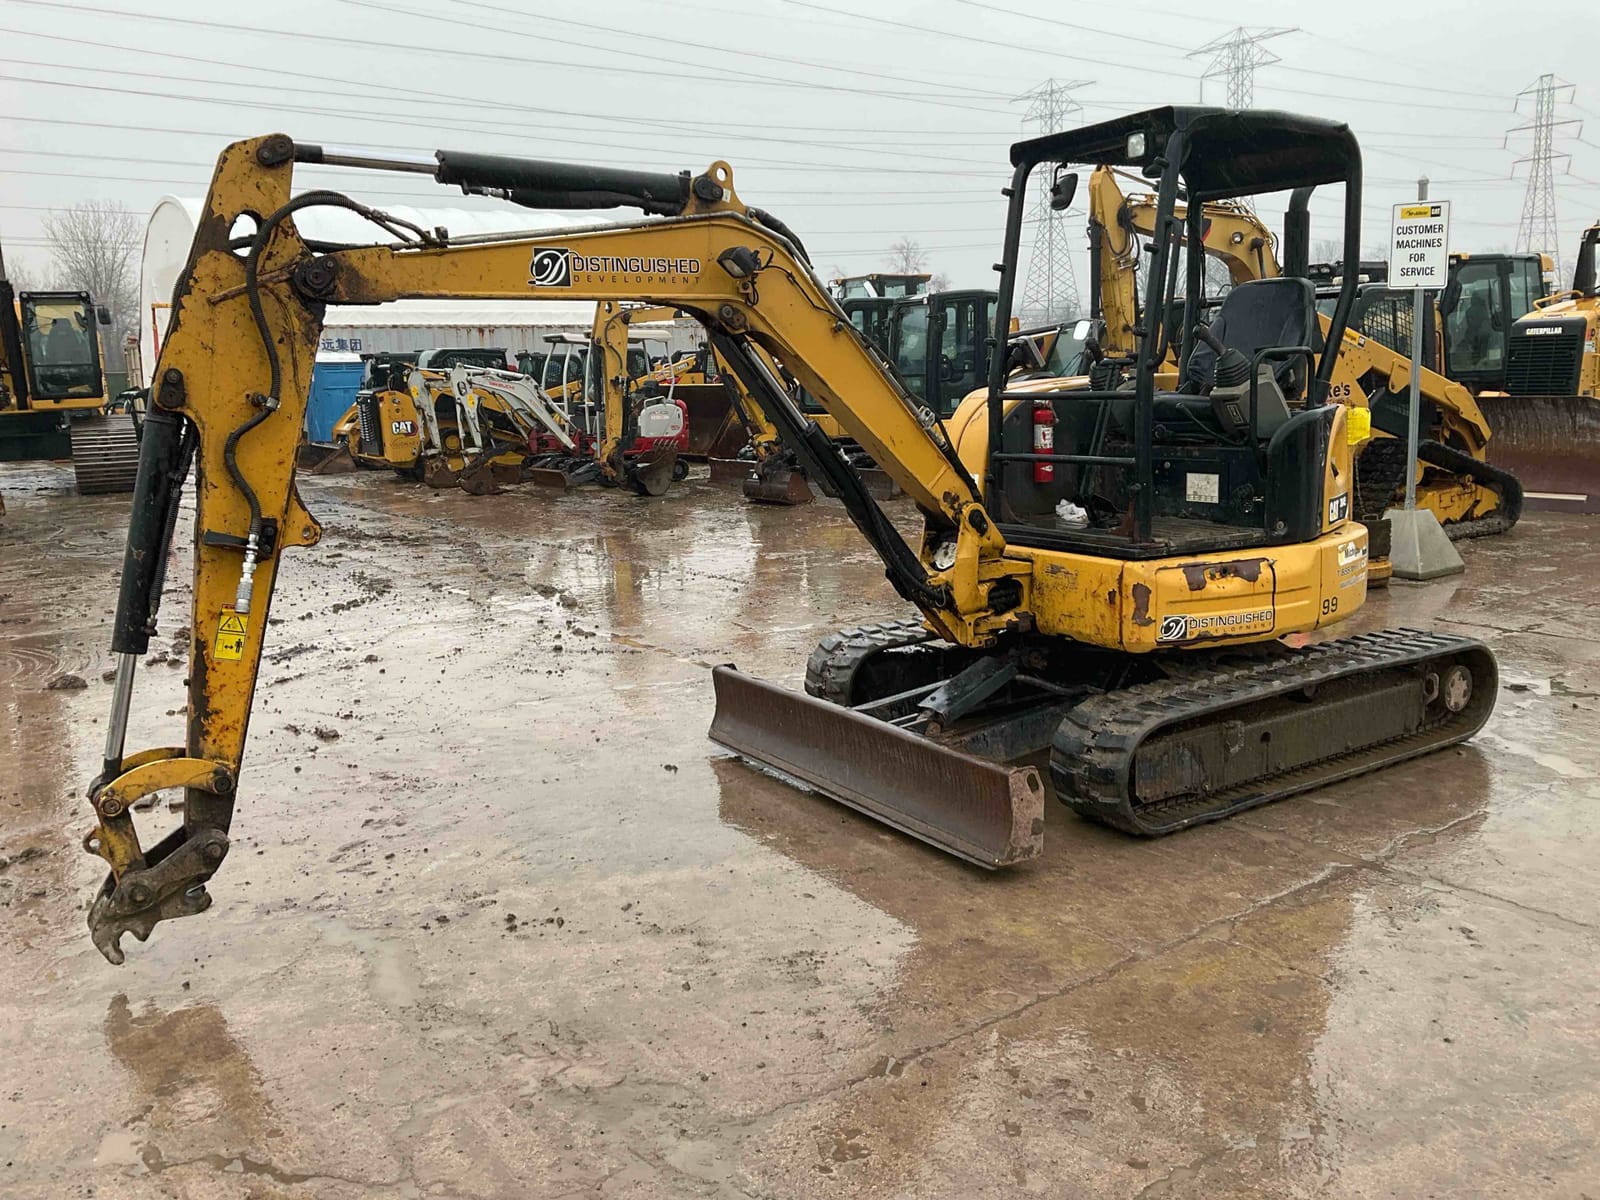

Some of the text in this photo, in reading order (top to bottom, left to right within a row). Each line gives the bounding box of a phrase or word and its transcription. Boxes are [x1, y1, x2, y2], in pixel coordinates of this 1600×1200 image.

[1396, 223, 1444, 236] CUSTOMER
[1396, 238, 1442, 249] MACHINES
[1409, 252, 1426, 263] FOR
[572, 256, 700, 274] DISTINGUISHED
[1400, 266, 1436, 277] SERVICE
[573, 275, 700, 284] DEVELOPMENT
[1526, 327, 1563, 336] CATERPILLAR
[392, 421, 412, 435] CAT
[1322, 597, 1338, 615] 99
[1189, 611, 1272, 629] DISTINGUISHED
